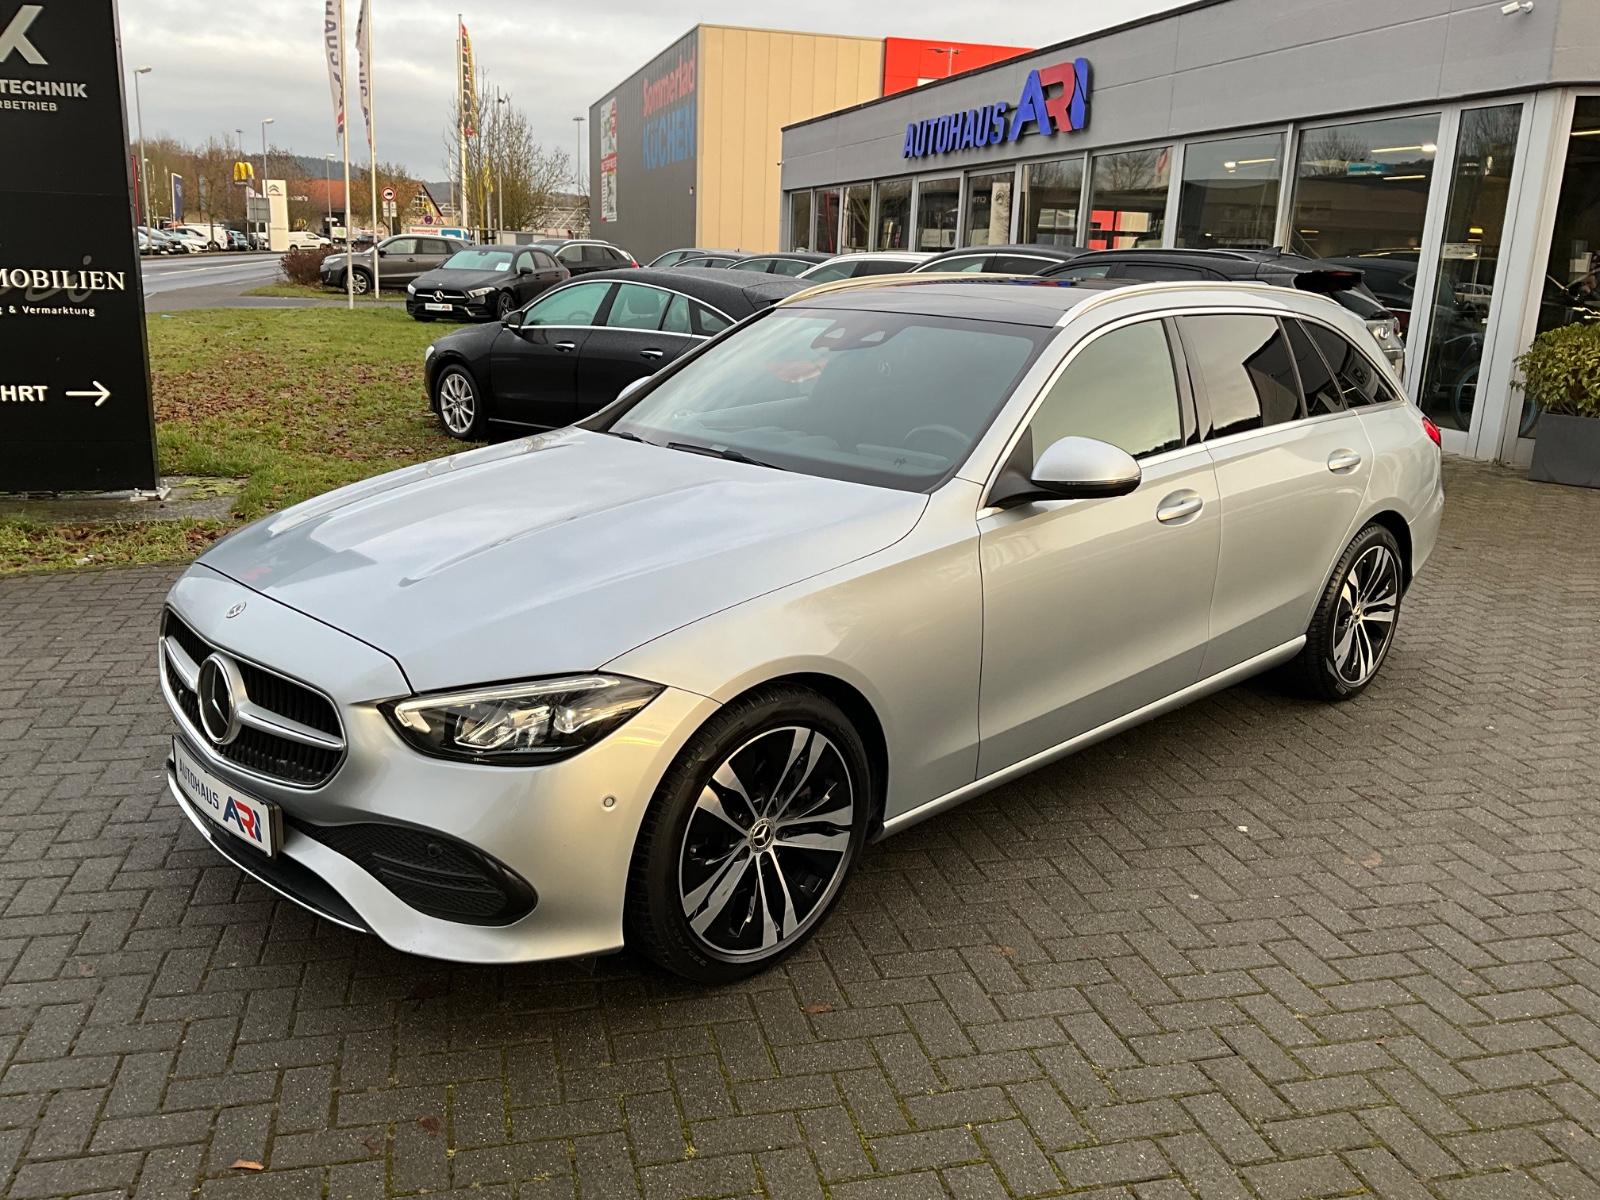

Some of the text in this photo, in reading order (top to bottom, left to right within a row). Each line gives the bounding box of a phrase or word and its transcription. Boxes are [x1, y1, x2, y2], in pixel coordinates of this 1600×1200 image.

[643, 49, 696, 116] Sommerlad
[903, 57, 1088, 158] AUTOHAUS ARI
[8, 305, 17, 314] &
[22, 305, 96, 317] Vermarktung
[179, 758, 219, 810] AUTOHAUS
[223, 796, 263, 843] ARI
